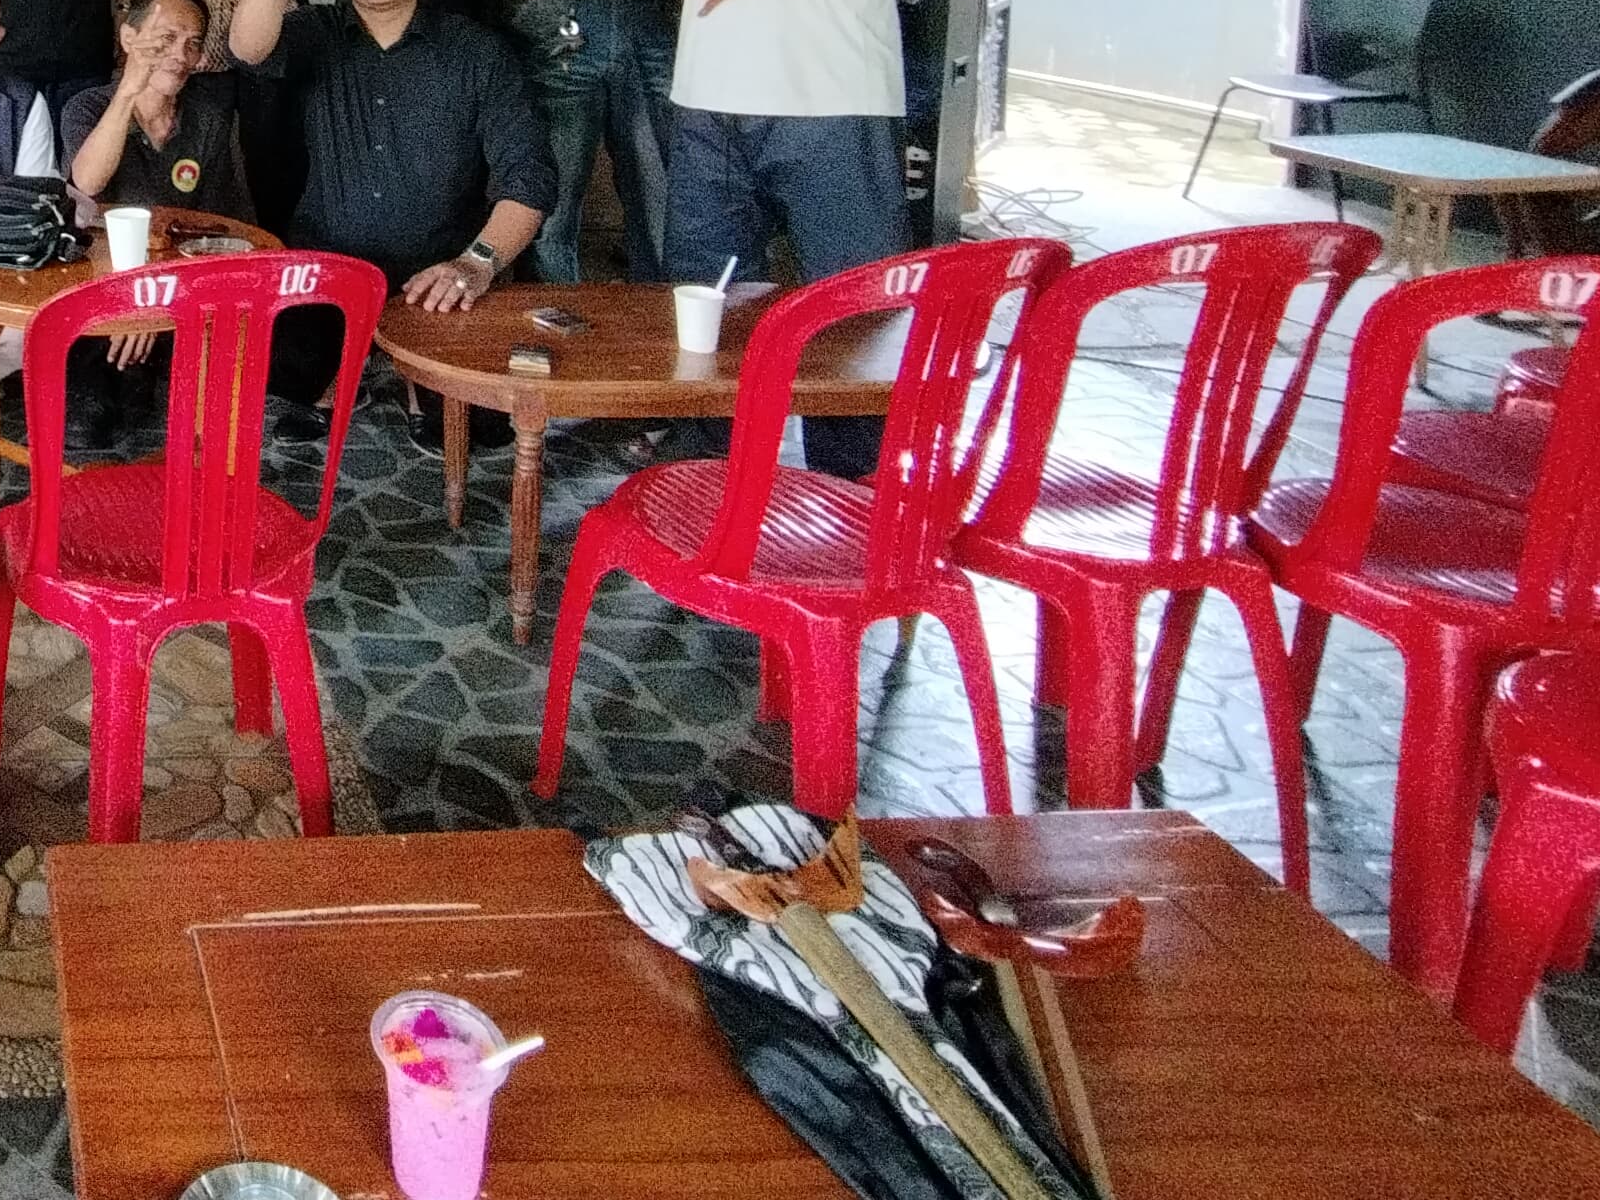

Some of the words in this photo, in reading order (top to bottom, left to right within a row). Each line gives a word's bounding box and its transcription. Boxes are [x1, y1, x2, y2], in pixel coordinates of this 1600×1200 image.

[1170, 243, 1220, 275] 07
[133, 274, 178, 307] 07
[884, 261, 930, 297] 07
[1539, 271, 1600, 307] 07
